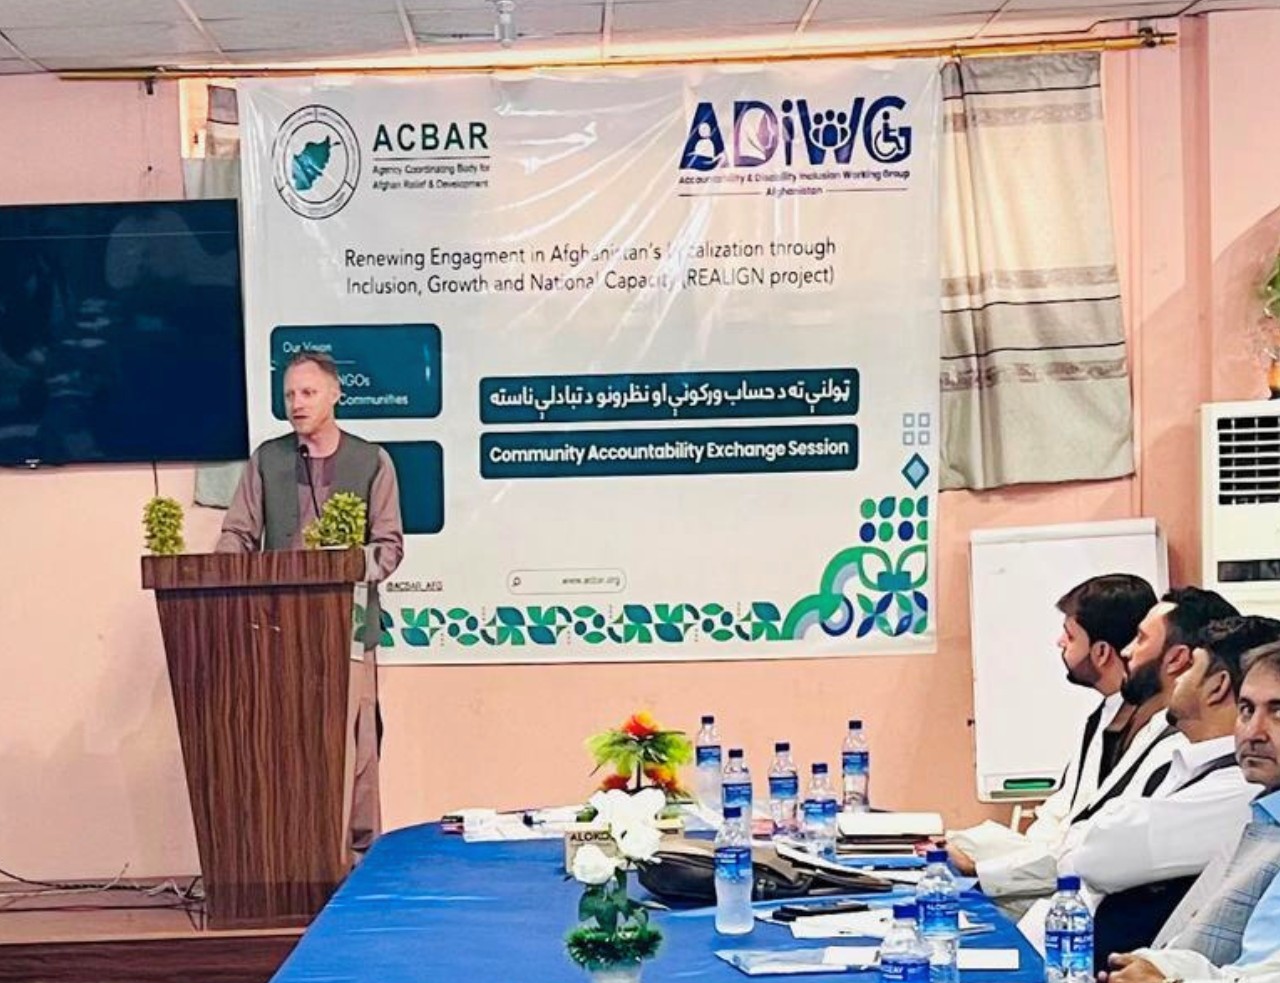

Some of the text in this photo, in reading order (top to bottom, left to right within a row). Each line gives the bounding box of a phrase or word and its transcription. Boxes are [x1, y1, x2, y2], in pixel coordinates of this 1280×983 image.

[372, 121, 489, 152] ACBAR
[344, 249, 425, 270] Renewing
[430, 247, 525, 269] Engagment
[531, 247, 544, 262] in
[551, 242, 662, 267] Afghanitan's
[770, 237, 836, 260] through
[347, 276, 422, 296] Inclusion,
[427, 274, 489, 293] Growth
[494, 274, 525, 291] and
[530, 272, 599, 291] National
[604, 270, 675, 291] Capacity
[770, 264, 835, 288] project)
[337, 373, 370, 387] NGOs
[723, 379, 776, 407] حساب
[338, 393, 409, 406] Communities
[651, 382, 667, 407] او
[490, 438, 849, 465] Community Accountability Exchange Session
[570, 830, 612, 842] ALOKO
